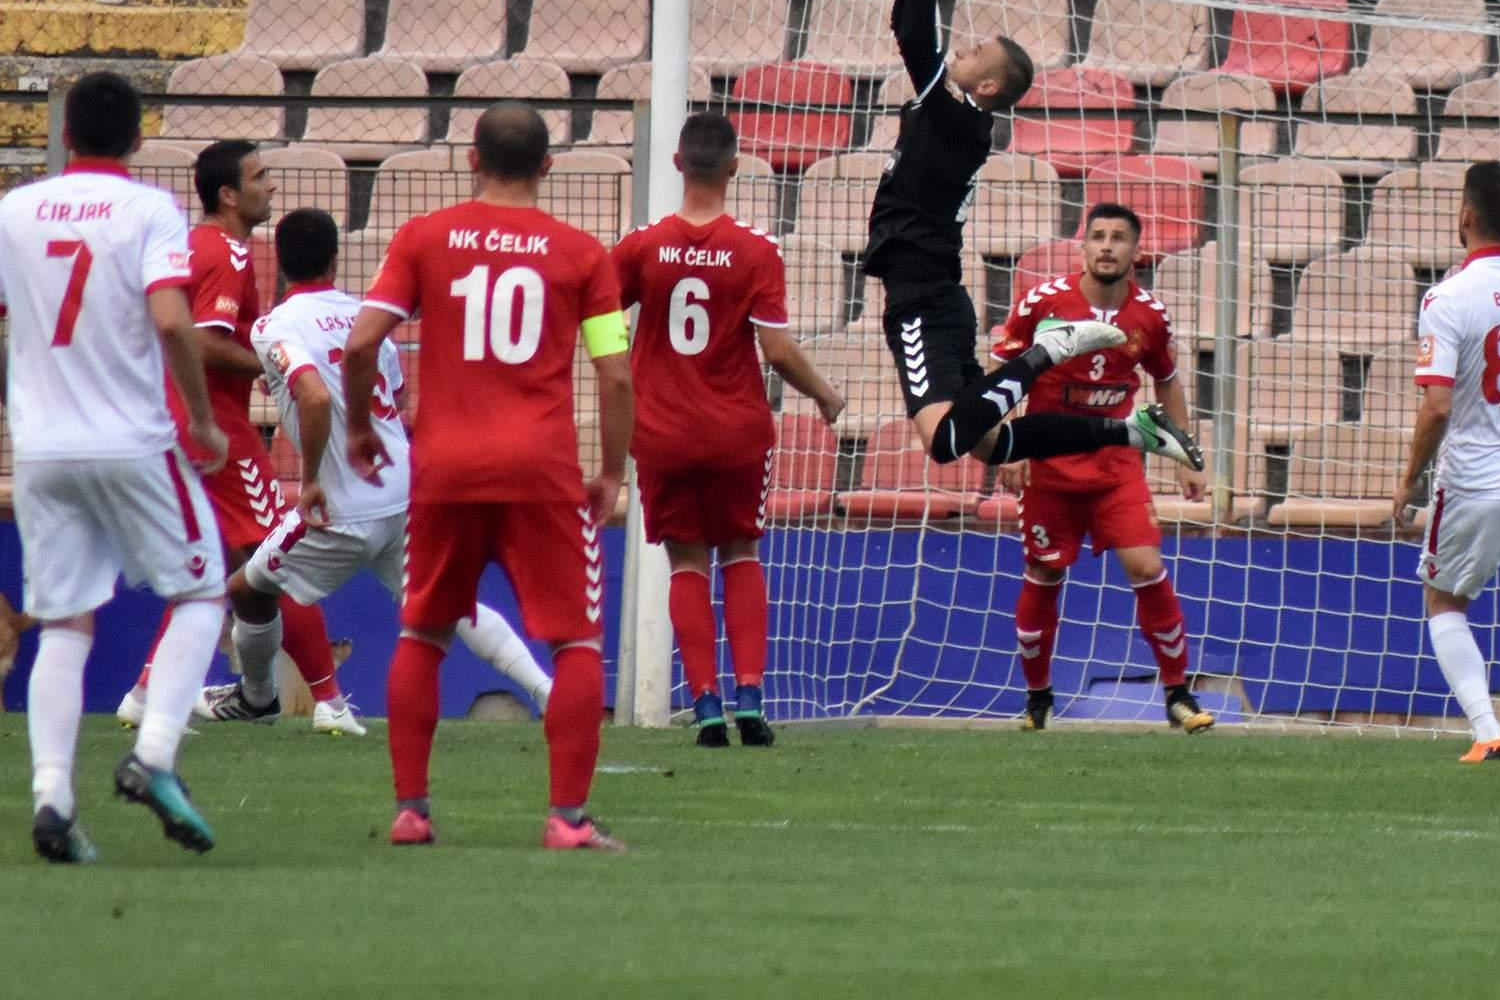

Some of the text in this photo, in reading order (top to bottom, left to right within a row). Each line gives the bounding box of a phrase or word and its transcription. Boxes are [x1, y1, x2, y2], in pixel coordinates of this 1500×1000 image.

[448, 228, 550, 256] NK ČELIK
[659, 246, 733, 268] NK ČELIK
[46, 238, 94, 347] 7
[449, 264, 545, 366] 10
[668, 277, 711, 357] 6
[1089, 354, 1106, 382] 3
[1031, 524, 1050, 549] 3
